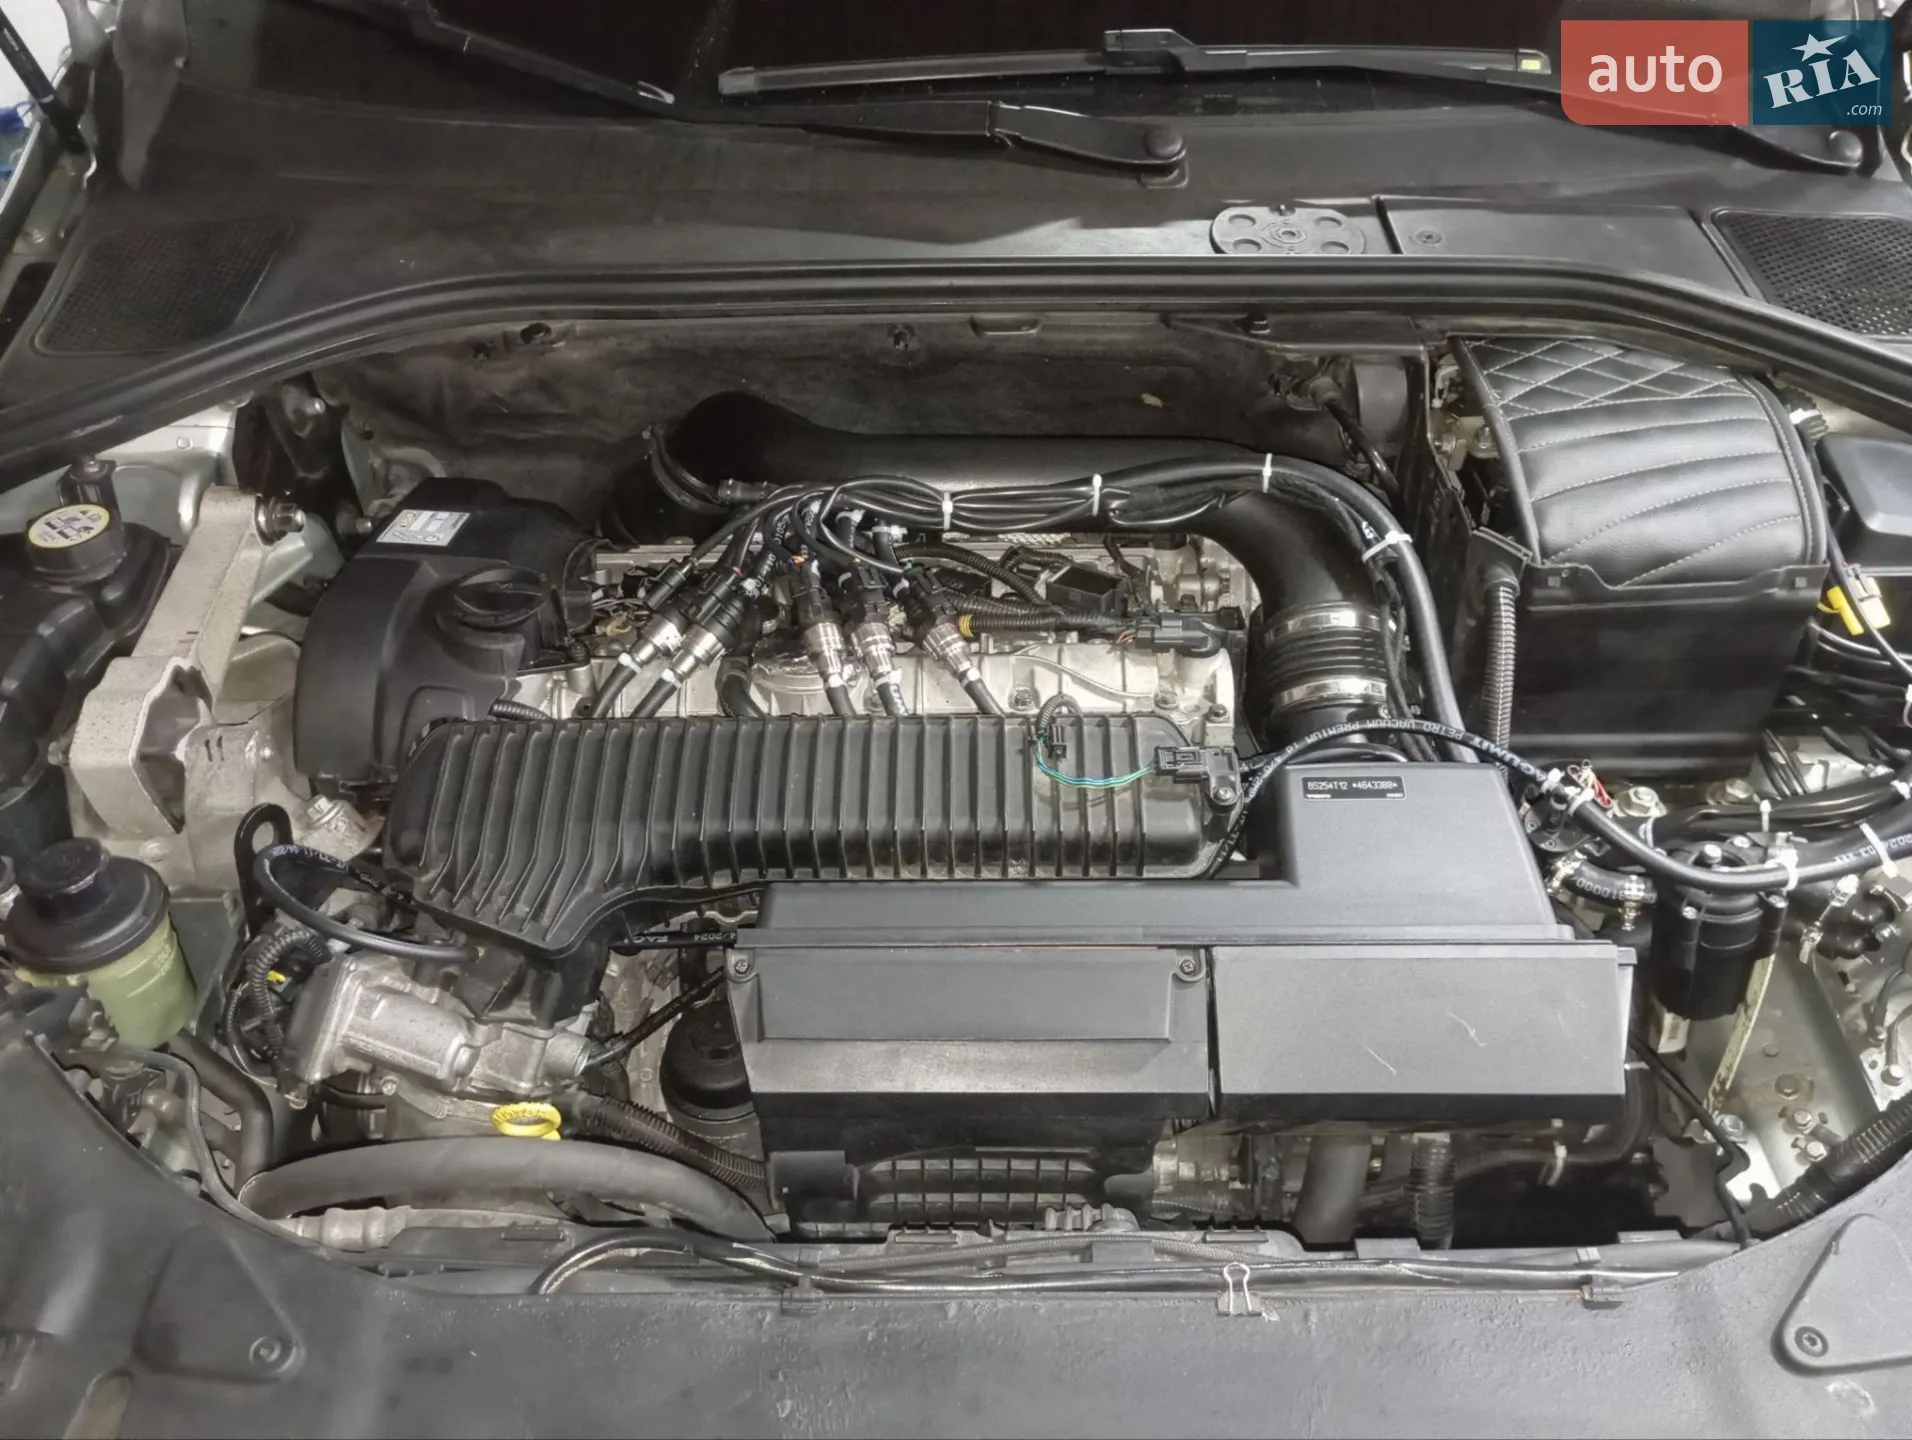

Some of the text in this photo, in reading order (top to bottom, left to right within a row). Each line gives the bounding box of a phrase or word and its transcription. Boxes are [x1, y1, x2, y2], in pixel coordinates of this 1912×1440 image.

[1305, 720, 1360, 744] PREMIUM
[1423, 723, 1464, 740] PETRO
[1472, 736, 1548, 783] AGUMIT
[1307, 781, 1348, 791] B5254T12
